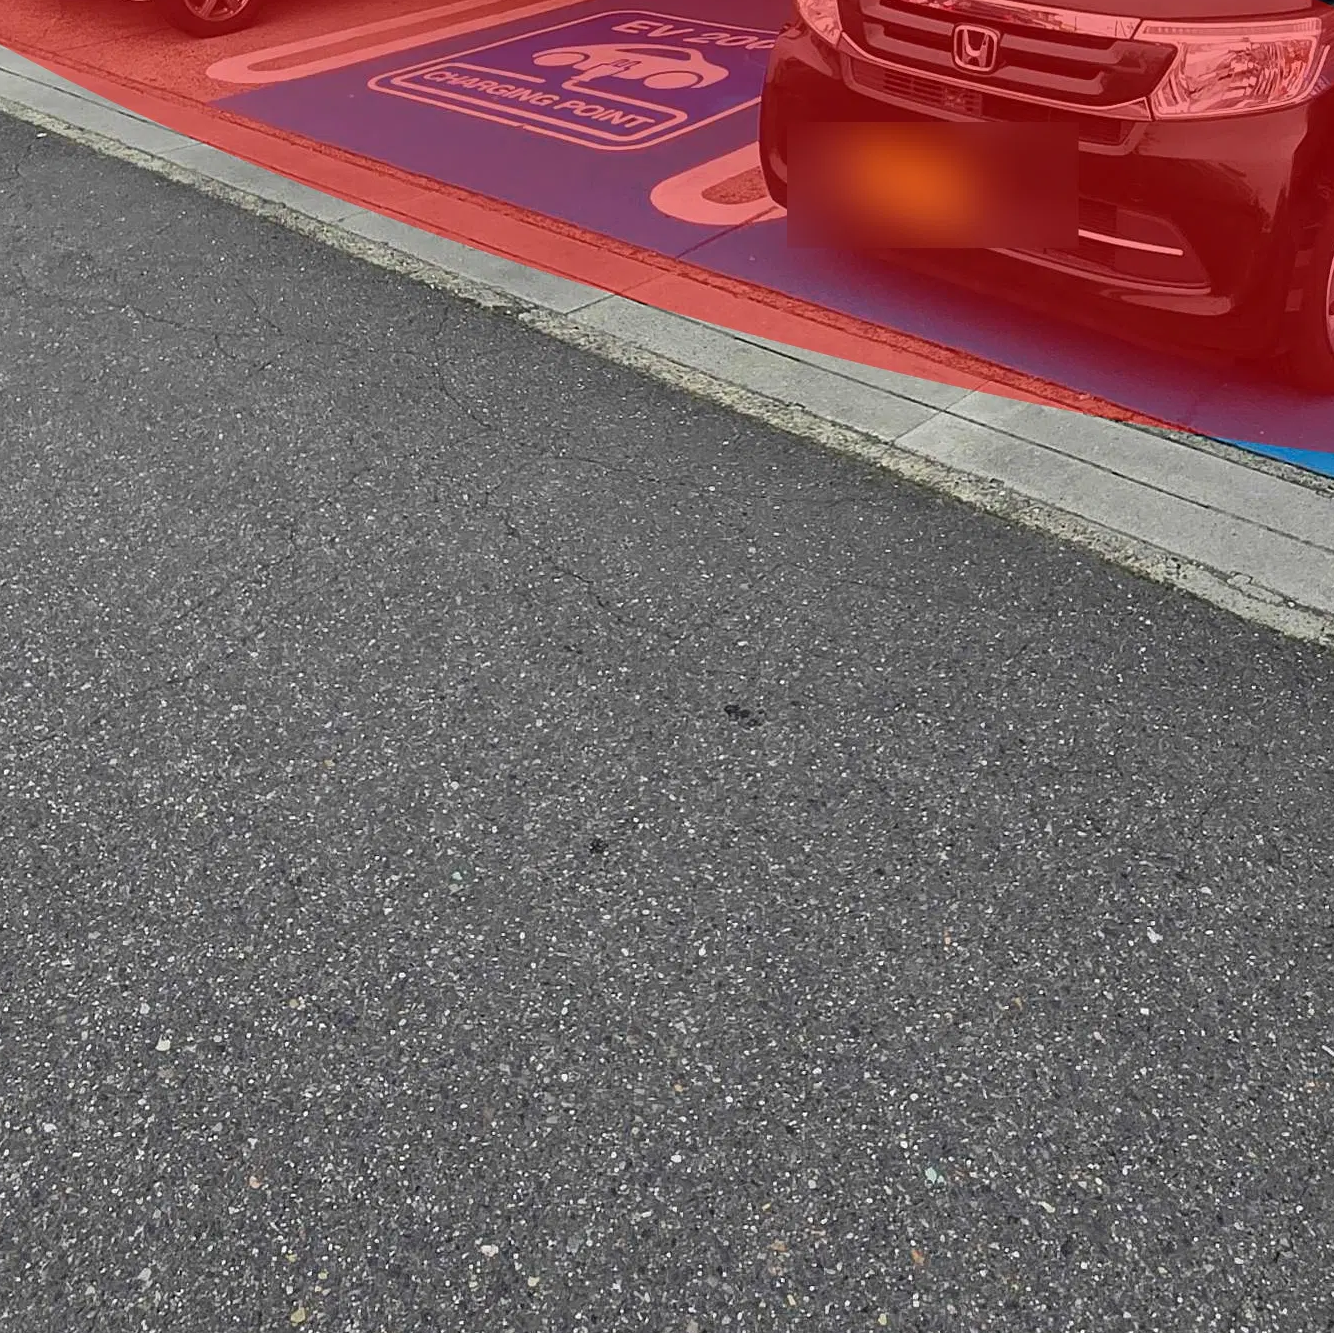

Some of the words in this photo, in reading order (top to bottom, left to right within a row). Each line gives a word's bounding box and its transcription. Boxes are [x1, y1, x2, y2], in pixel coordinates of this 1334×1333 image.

[610, 19, 695, 40] EV
[423, 70, 561, 106] CHARGING
[553, 93, 656, 130] POINT
